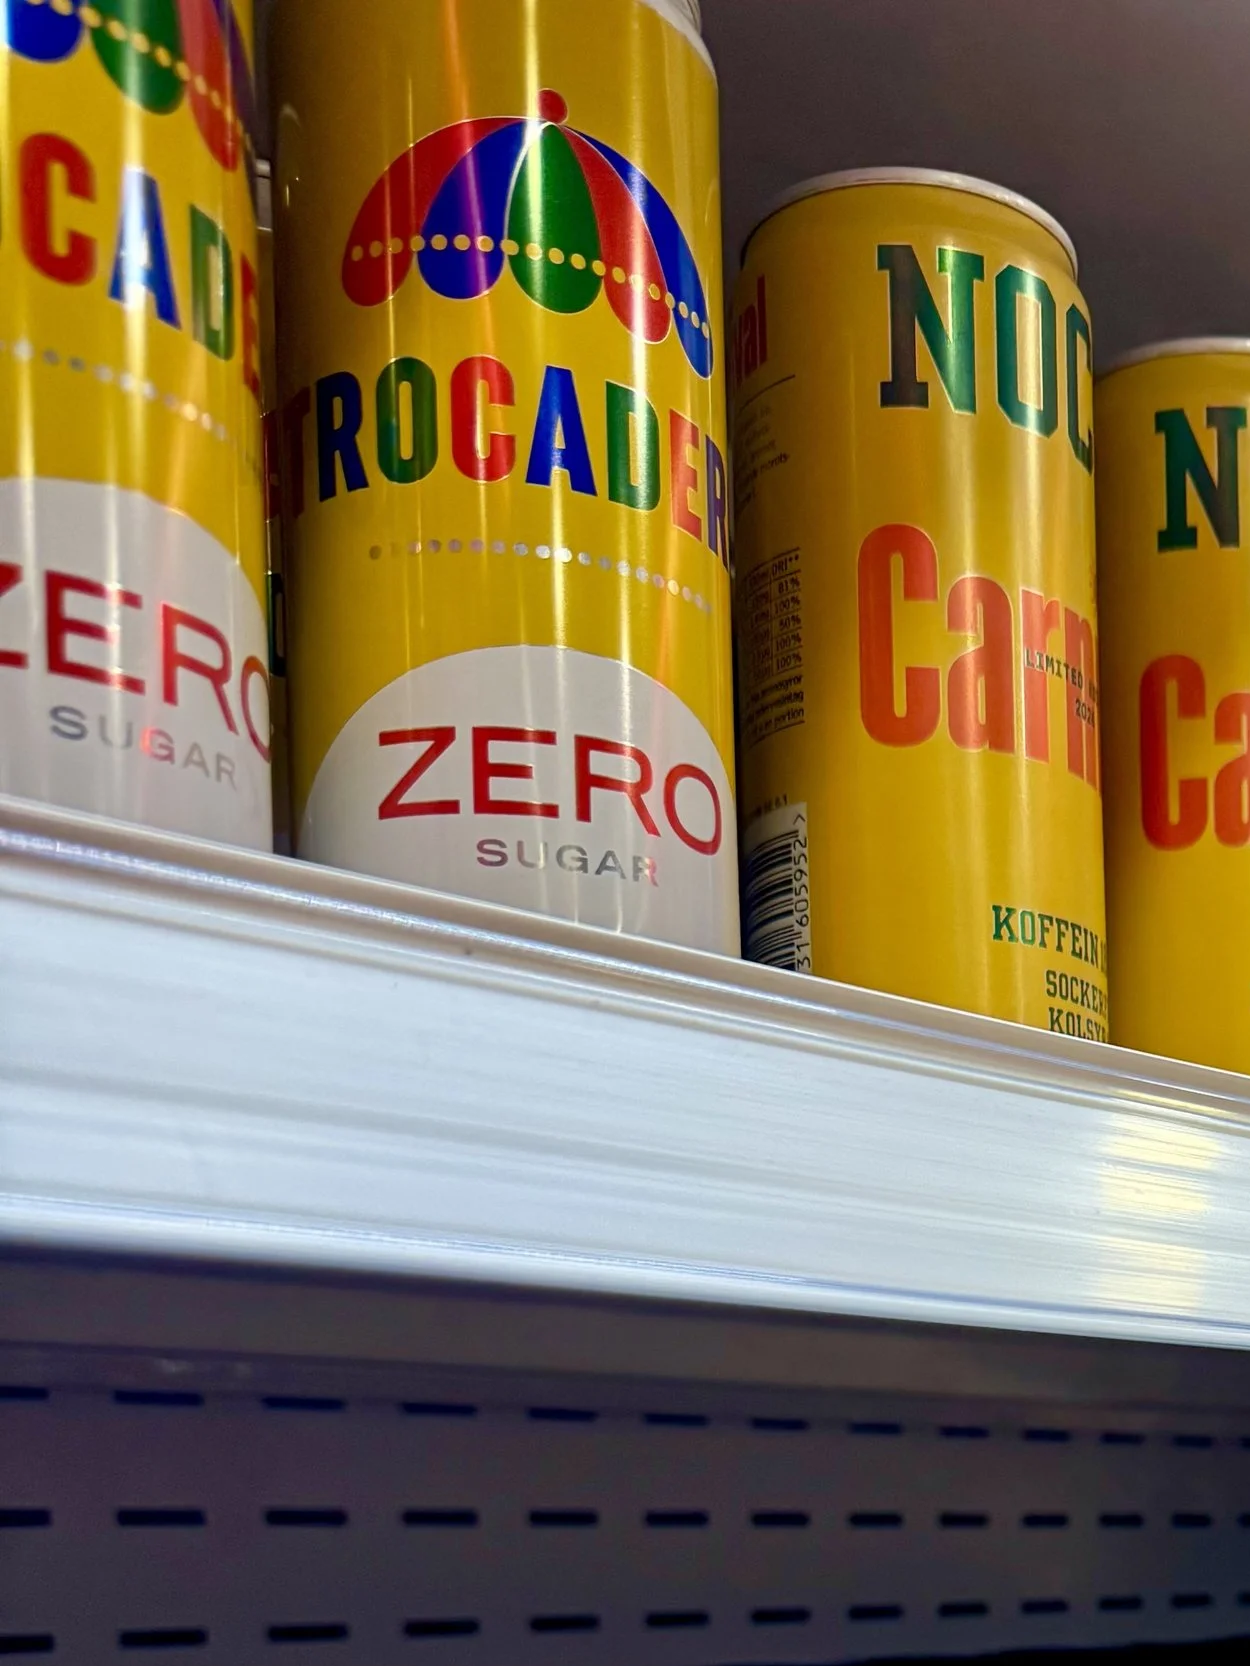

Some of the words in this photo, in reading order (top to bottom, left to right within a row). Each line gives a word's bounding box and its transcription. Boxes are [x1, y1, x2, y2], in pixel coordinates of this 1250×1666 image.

[876, 244, 1093, 477] NOC
[1024, 647, 1084, 691] LIMITED
[50, 704, 239, 792] SUGAR
[378, 726, 722, 856] ZERO
[476, 839, 660, 888] SUGAR
[991, 904, 1099, 969] KOFFEIN
